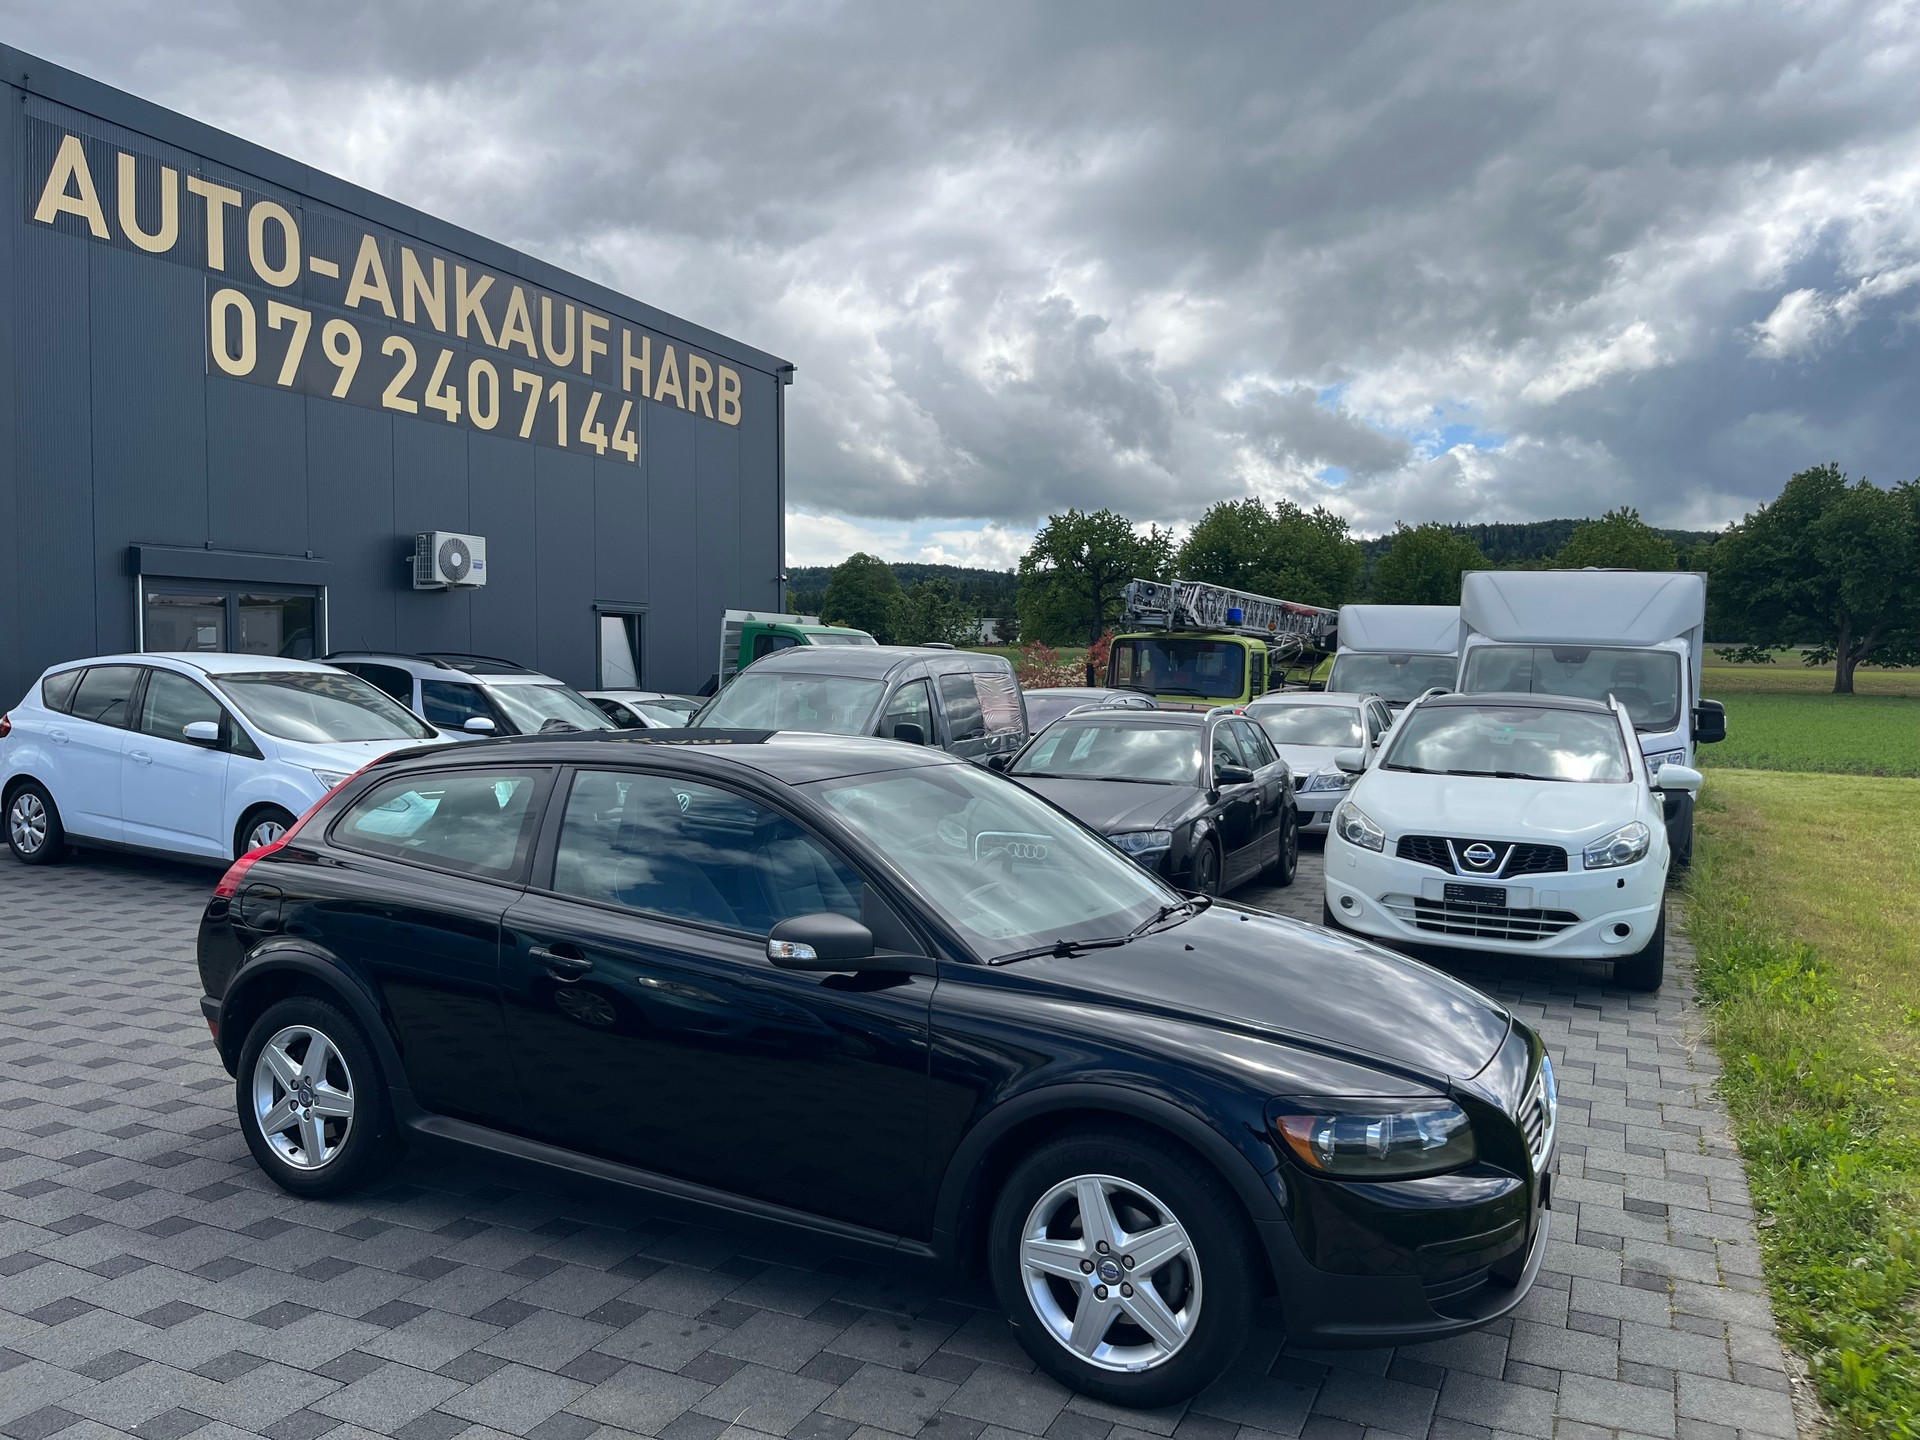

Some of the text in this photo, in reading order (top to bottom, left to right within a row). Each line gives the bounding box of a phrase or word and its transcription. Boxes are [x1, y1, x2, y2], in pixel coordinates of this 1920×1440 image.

[34, 134, 742, 425] AUTO-ANKAUF HARB
[211, 289, 362, 398] 079
[382, 335, 500, 430] 240
